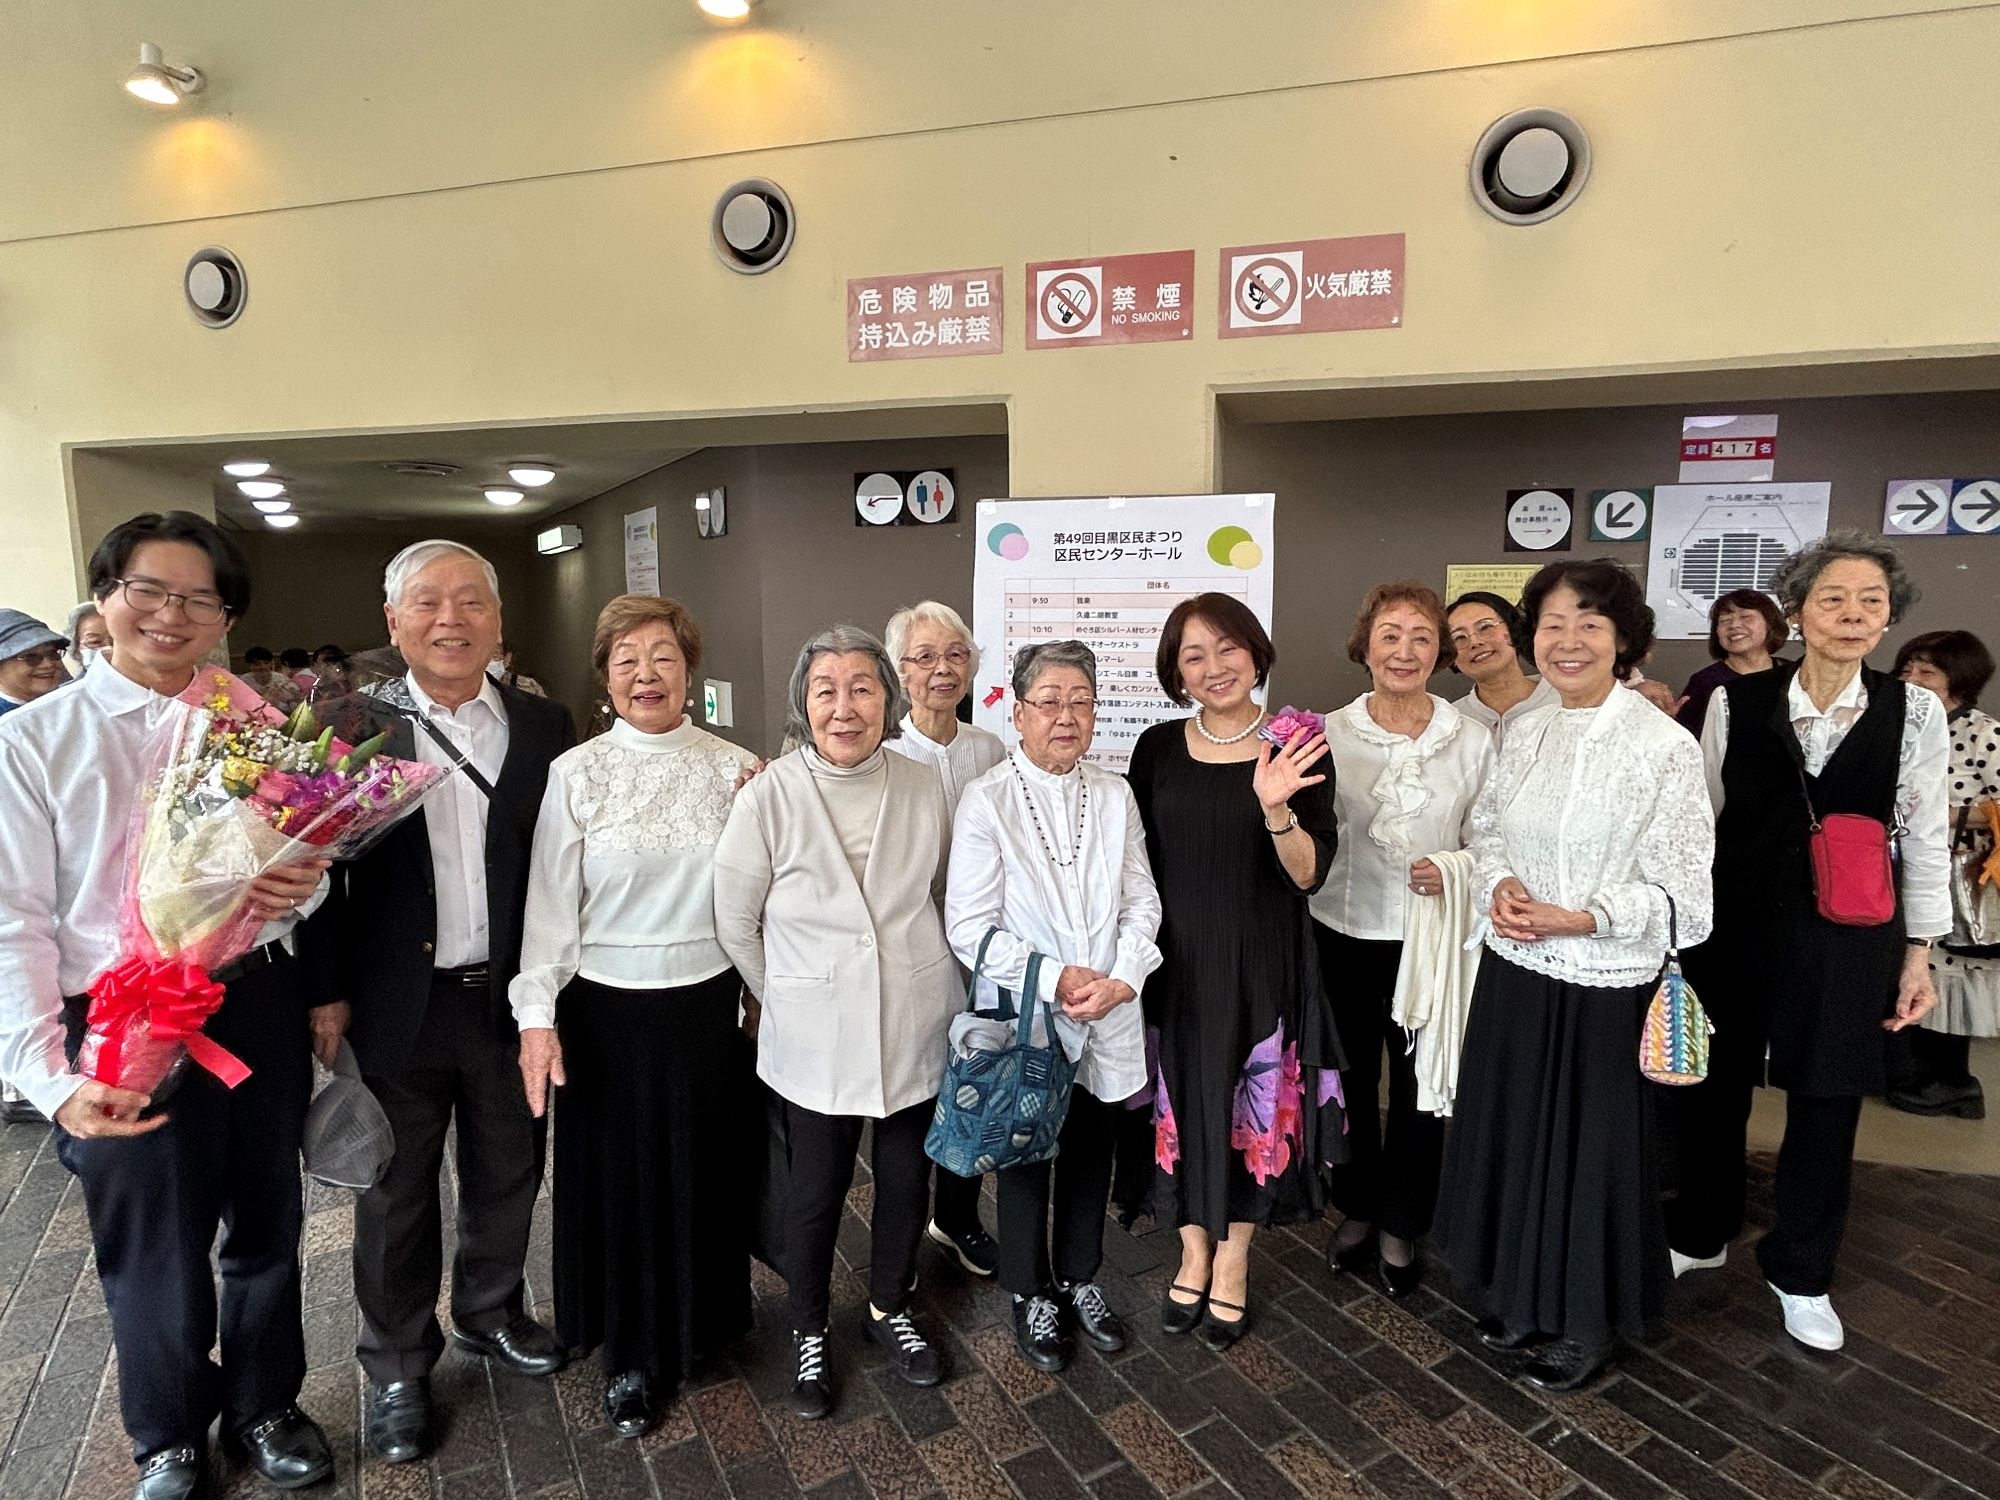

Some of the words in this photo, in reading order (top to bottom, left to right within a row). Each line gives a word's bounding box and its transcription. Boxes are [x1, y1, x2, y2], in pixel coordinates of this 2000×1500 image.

[1305, 268, 1392, 300] 火気厳禁
[858, 280, 990, 316] 危険物品
[1112, 283, 1181, 312] 禁煙
[1112, 314, 1127, 324] NO
[1131, 310, 1180, 324] SMOKING
[859, 315, 991, 350] 持込み厳禁
[1053, 531, 1183, 545] 第49回目黒区民まつり
[1054, 547, 1183, 562] 区民センターホール
[1147, 581, 1170, 590] 団体名
